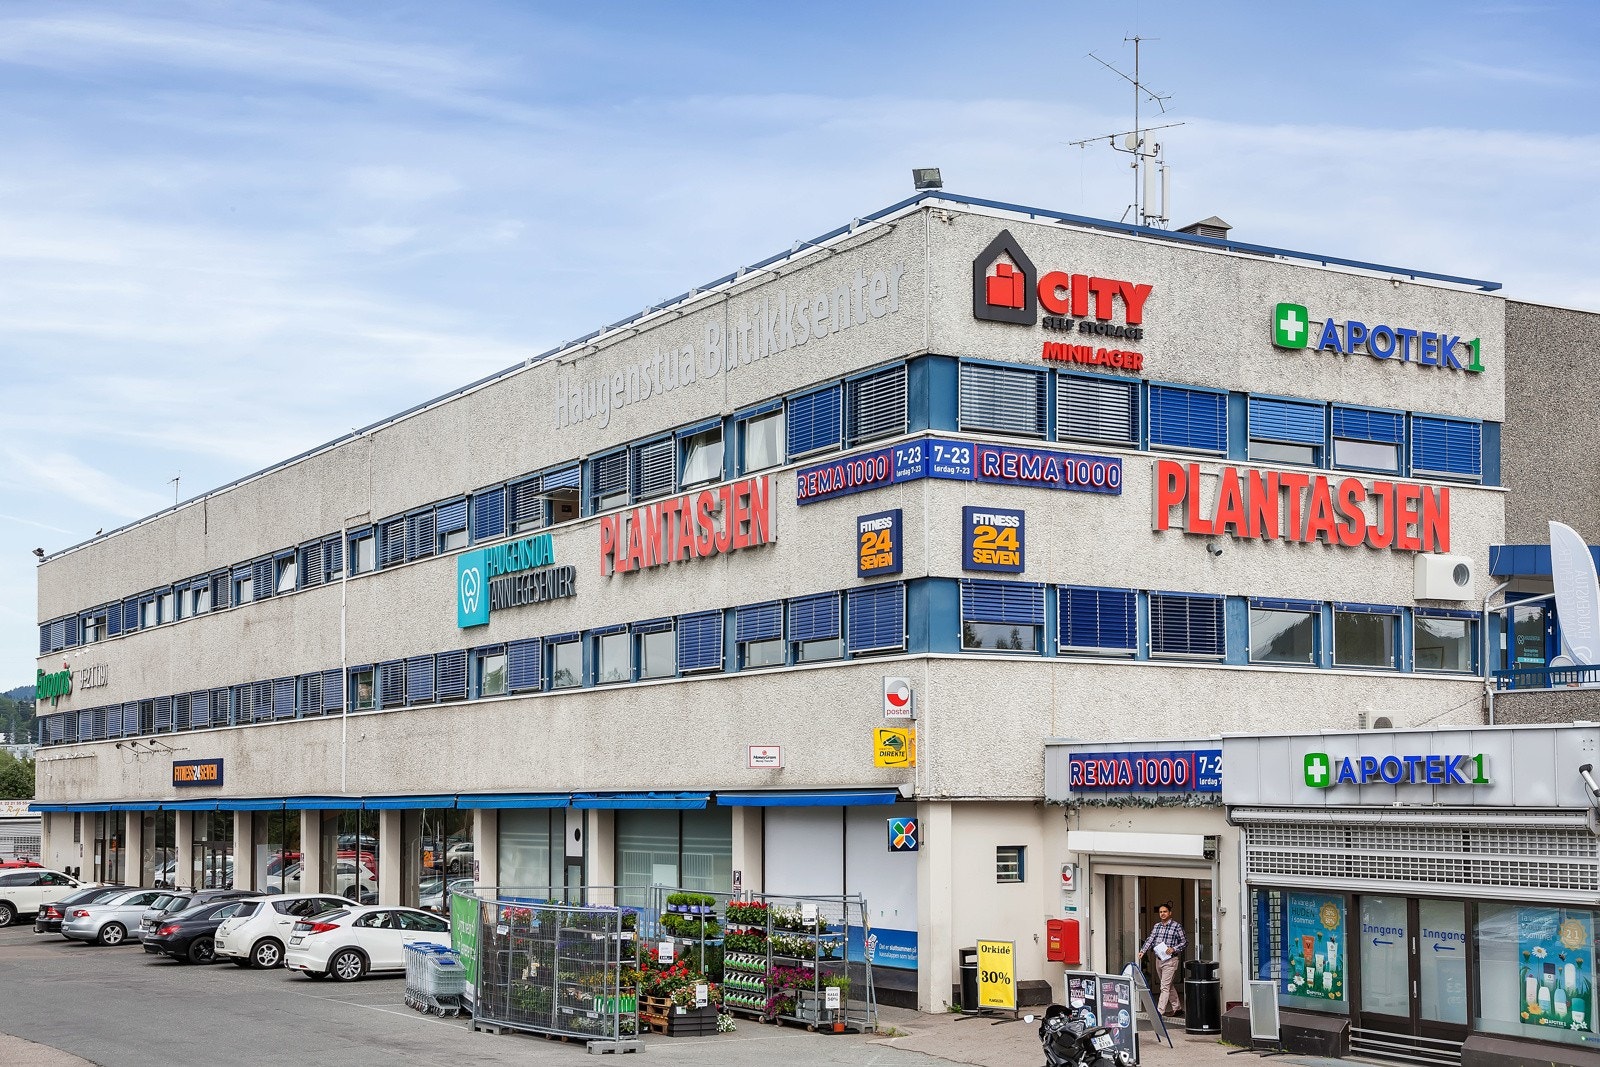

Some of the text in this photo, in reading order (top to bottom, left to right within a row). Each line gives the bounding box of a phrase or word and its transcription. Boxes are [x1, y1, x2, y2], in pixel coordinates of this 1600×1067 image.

[1037, 271, 1153, 325] CITY
[1042, 316, 1143, 340] SELF STORAGE
[554, 261, 905, 430] Haugenstua Butikksenter
[1042, 341, 1143, 370] MINILAGER
[1318, 317, 1463, 369] APOTEK
[896, 446, 922, 465] 7-23
[933, 445, 970, 464] 7-23
[796, 455, 889, 499] REMA 1000
[896, 467, 914, 478] lørdag
[933, 464, 970, 475] lørdag 7-23
[981, 451, 1121, 489] REMA 1000
[1153, 459, 1450, 553] PLANTASJEN
[600, 475, 775, 577] PLANTASJEN
[860, 516, 892, 533] FITNESS
[972, 512, 1020, 528] FITNESS
[860, 529, 892, 556] 24
[972, 525, 1020, 551] 24
[486, 533, 555, 578] HAUGENSTUA
[860, 553, 893, 571] SEVEN
[972, 549, 1020, 566] SEVEN
[488, 565, 576, 612] TANNLEGESENTER
[886, 708, 910, 716] posten
[1069, 758, 1189, 786] REMA 1000
[1338, 753, 1491, 784] APOTEK 1
[1363, 924, 1403, 938] Inngang
[1423, 928, 1466, 943] Inngang
[981, 944, 1011, 955] Orkidé
[981, 970, 1011, 985] 30%
